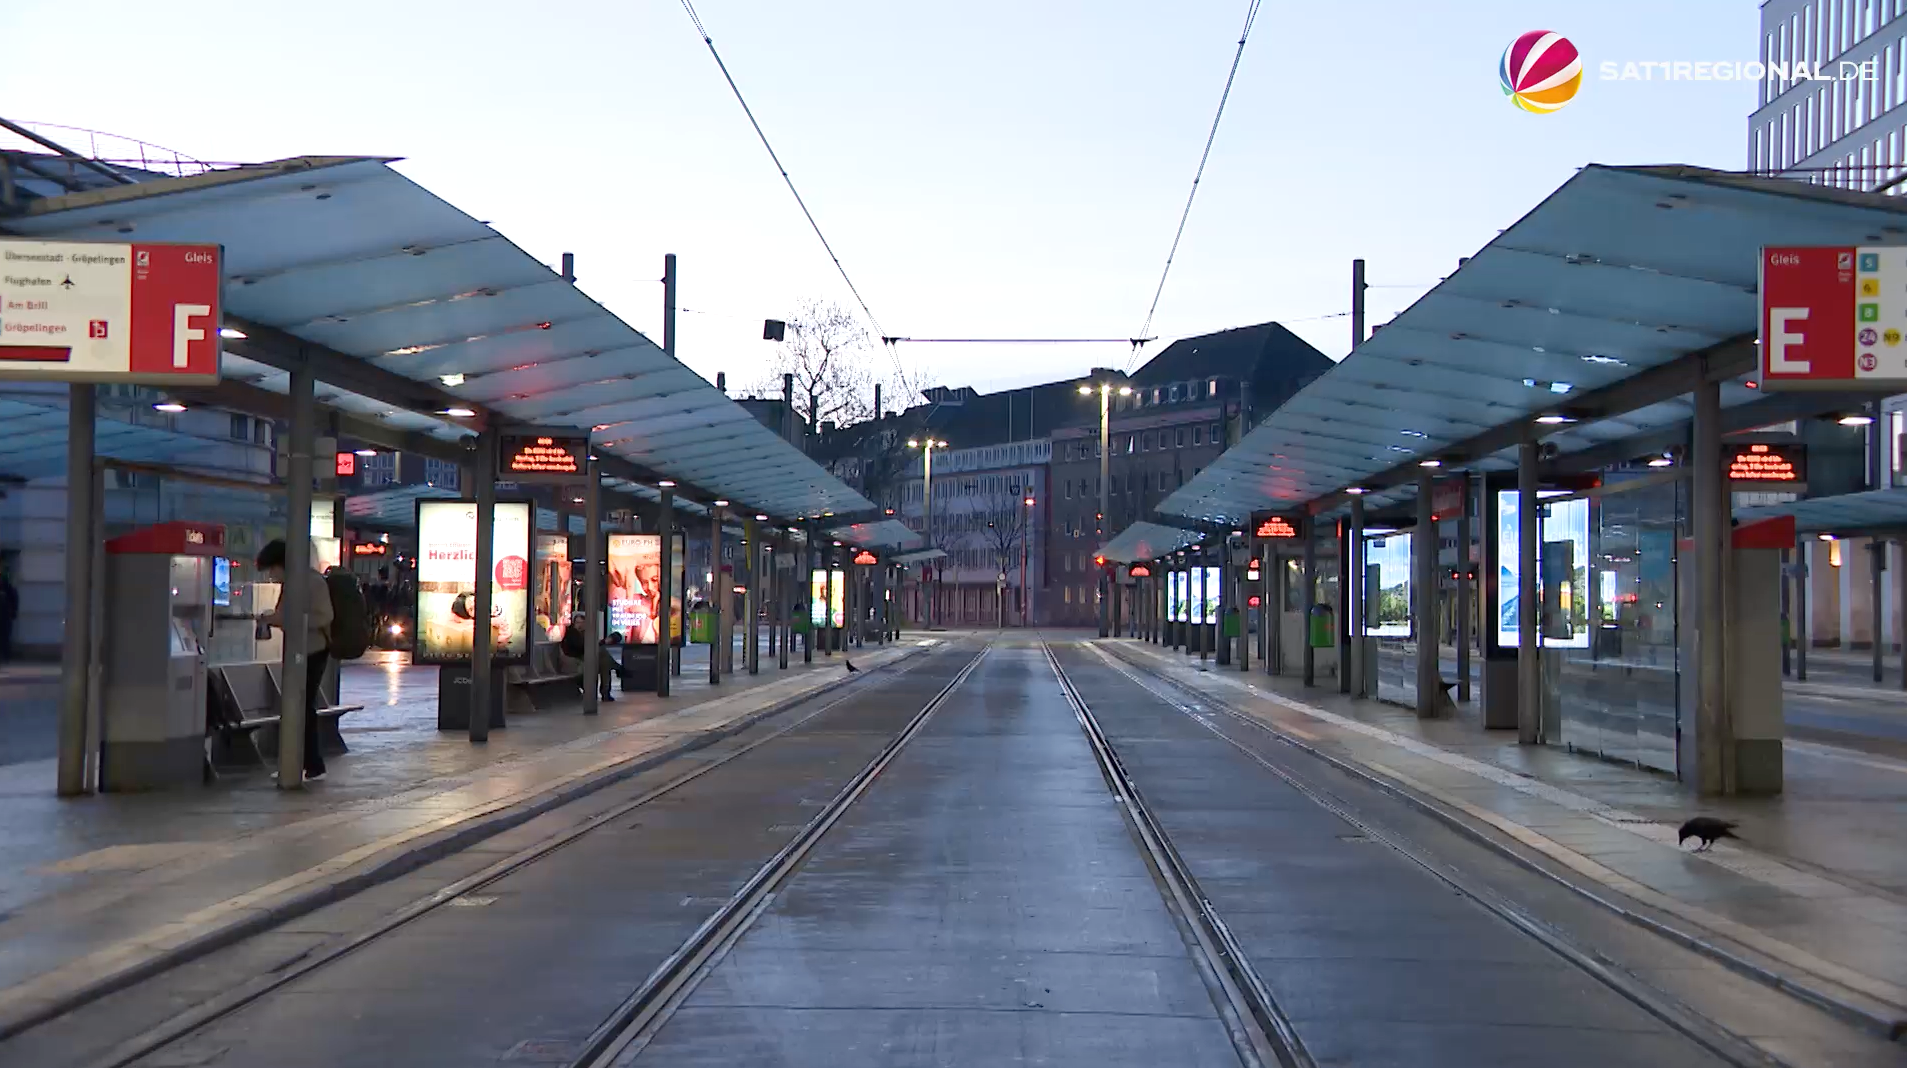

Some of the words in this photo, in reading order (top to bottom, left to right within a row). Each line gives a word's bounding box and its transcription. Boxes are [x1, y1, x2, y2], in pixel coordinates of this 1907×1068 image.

[5, 250, 63, 262] Überseestadt
[72, 253, 126, 266] Gröpelingen
[184, 251, 214, 265] Gleis
[1770, 253, 1801, 266] Gleis
[5, 275, 52, 287] Flughafen
[8, 301, 24, 310] Am
[26, 300, 49, 310] Brill
[4, 323, 68, 334] Gröpelingen
[172, 303, 212, 368] F
[1769, 307, 1810, 373] E
